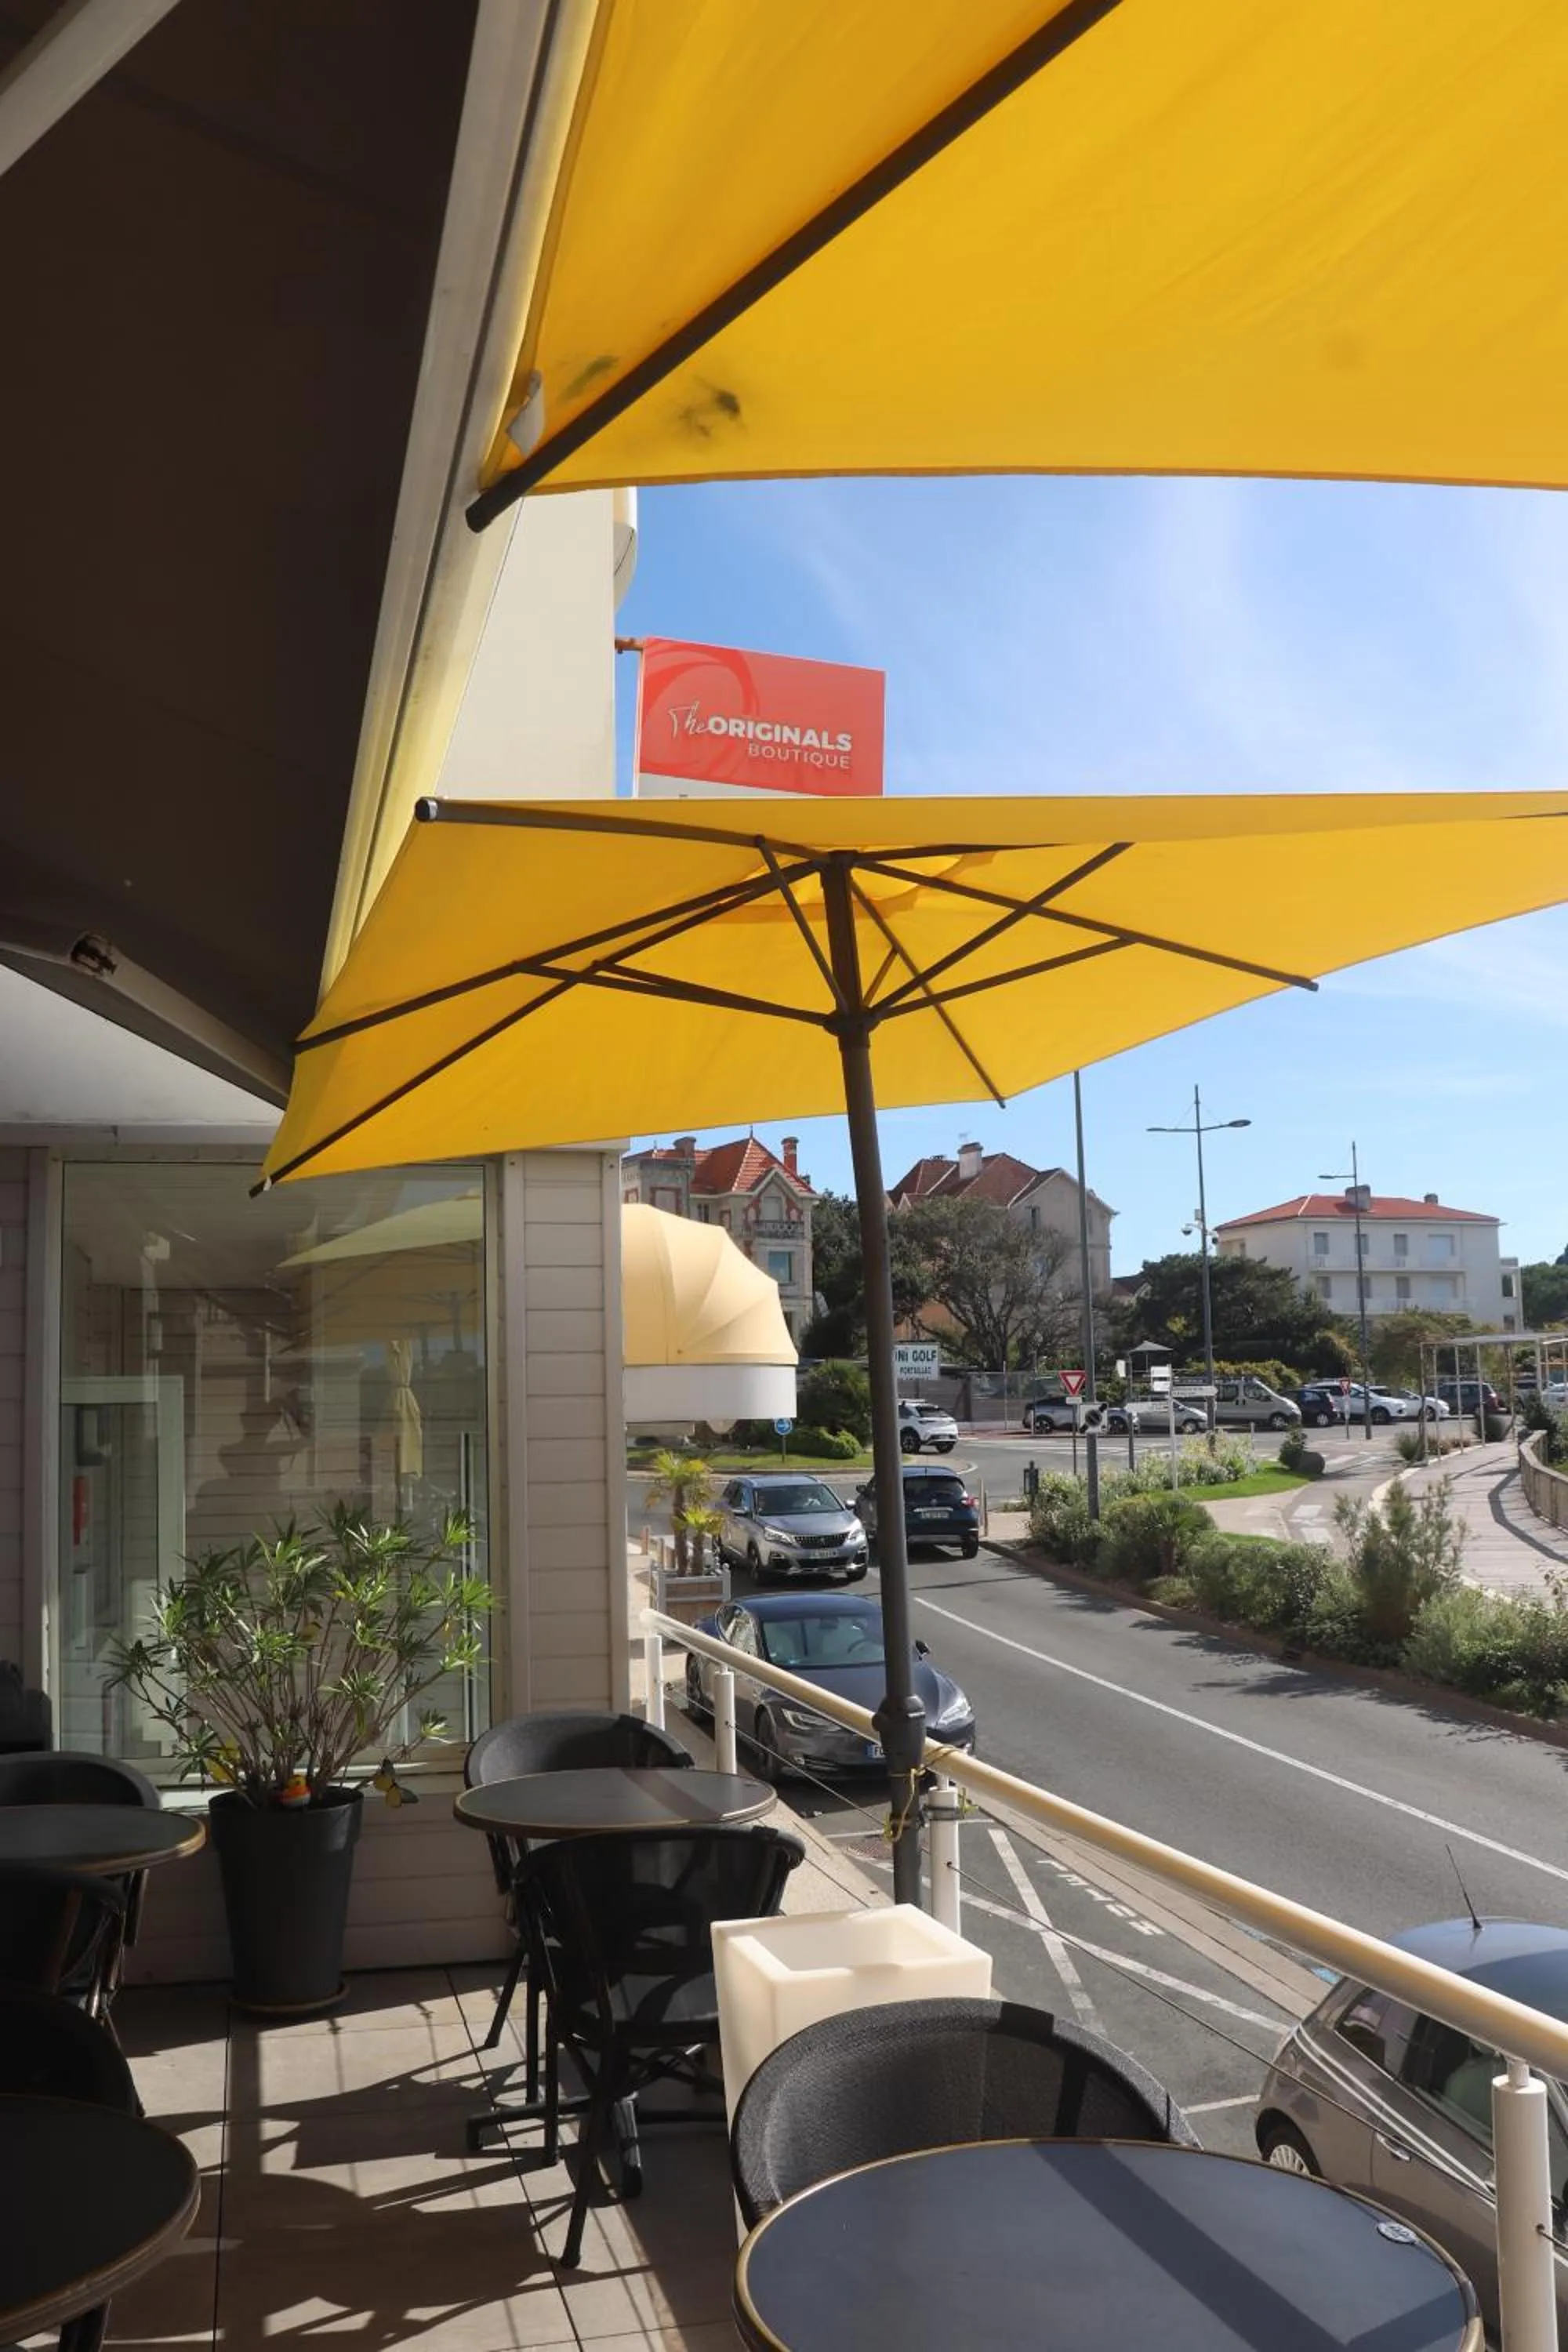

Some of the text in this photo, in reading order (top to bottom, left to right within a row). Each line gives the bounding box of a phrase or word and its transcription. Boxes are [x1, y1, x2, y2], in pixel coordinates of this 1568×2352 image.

[669, 700, 852, 752] The ORIGINALS
[749, 742, 850, 769] BOUTIQUE
[912, 1349, 937, 1362] GOLF
